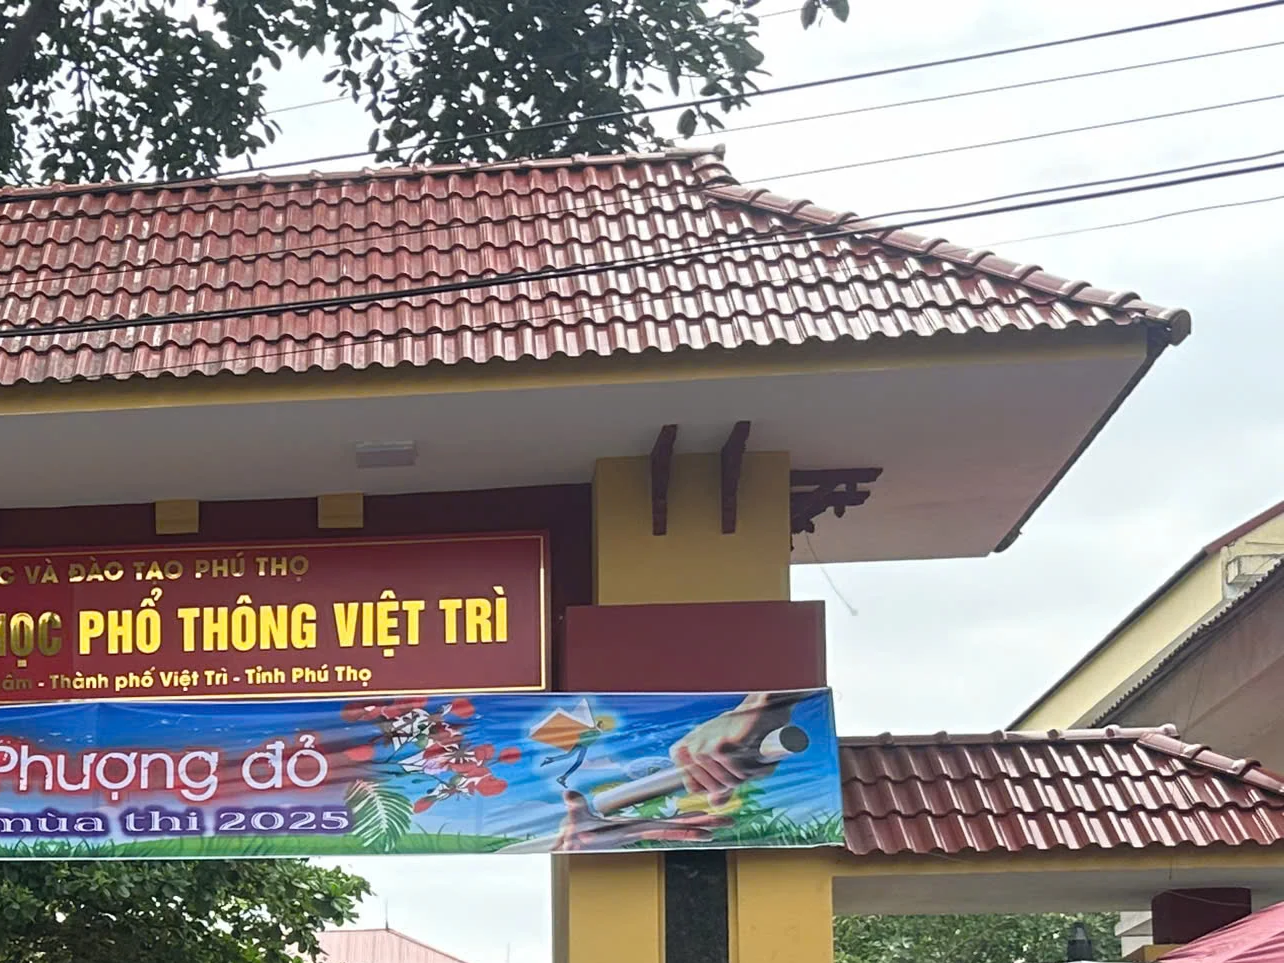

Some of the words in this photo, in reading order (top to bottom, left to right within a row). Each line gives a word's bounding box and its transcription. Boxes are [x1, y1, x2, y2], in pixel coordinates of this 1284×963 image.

[24, 558, 59, 585] VÀ
[68, 556, 124, 582] ĐÀO
[133, 560, 184, 585] TẠO
[195, 552, 245, 579] PHÚ
[256, 555, 309, 582] THỌ
[79, 588, 162, 655] PHỔ
[178, 595, 316, 652] THÔNG
[333, 590, 425, 657] VIỆT
[439, 586, 508, 643] TRÌ
[49, 671, 109, 689] Thành
[115, 667, 156, 691] phố
[160, 669, 201, 688] Việt
[204, 667, 229, 685] Trì
[245, 665, 285, 685] Tỉnh
[292, 664, 328, 683] Phú
[335, 665, 372, 687] Thọ
[241, 734, 329, 790] đỏ
[125, 811, 201, 832] thi
[218, 811, 349, 832] 2025
